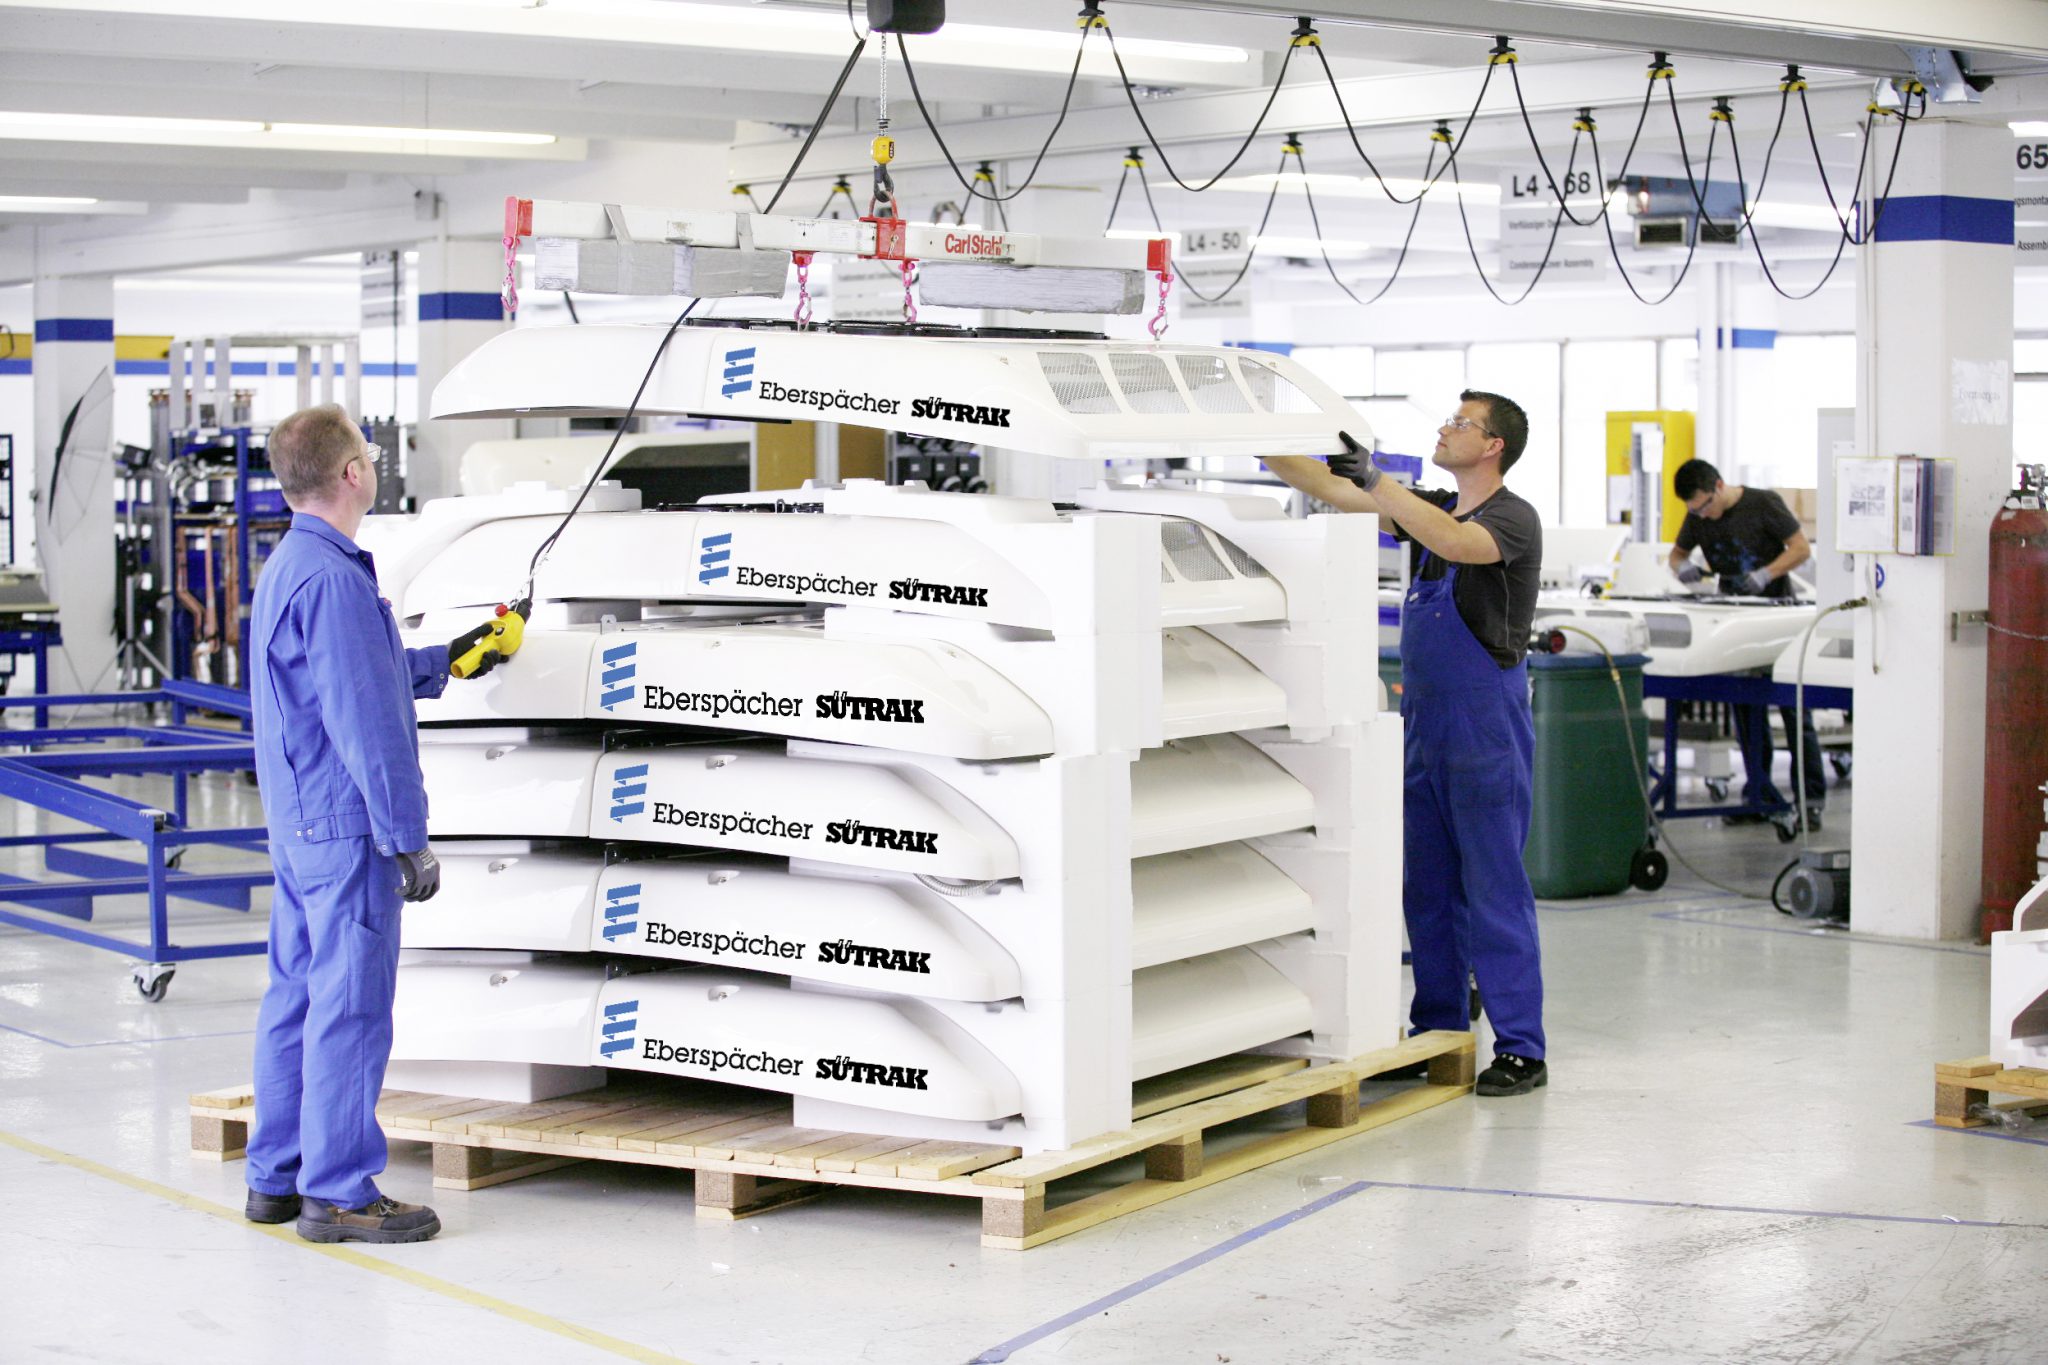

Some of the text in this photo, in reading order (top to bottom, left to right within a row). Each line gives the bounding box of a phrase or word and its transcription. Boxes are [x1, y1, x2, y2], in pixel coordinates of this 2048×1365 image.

[2016, 144, 2048, 169] 65
[1513, 175, 1538, 197] L4
[1564, 172, 1591, 194] 68
[1187, 235, 1206, 252] L4
[1222, 232, 1241, 250] 50
[759, 381, 1010, 428] Eberspächer SÜTRAK
[736, 566, 988, 607] Eberspächer SÜTRAK
[644, 685, 925, 723] Eberspächer SÜTRAK
[652, 802, 938, 854] Eberspächer SÜTRAK
[645, 922, 931, 974] Eberspächer SÜTRAK
[642, 1038, 928, 1090] Eberspächer SÜTRAK
